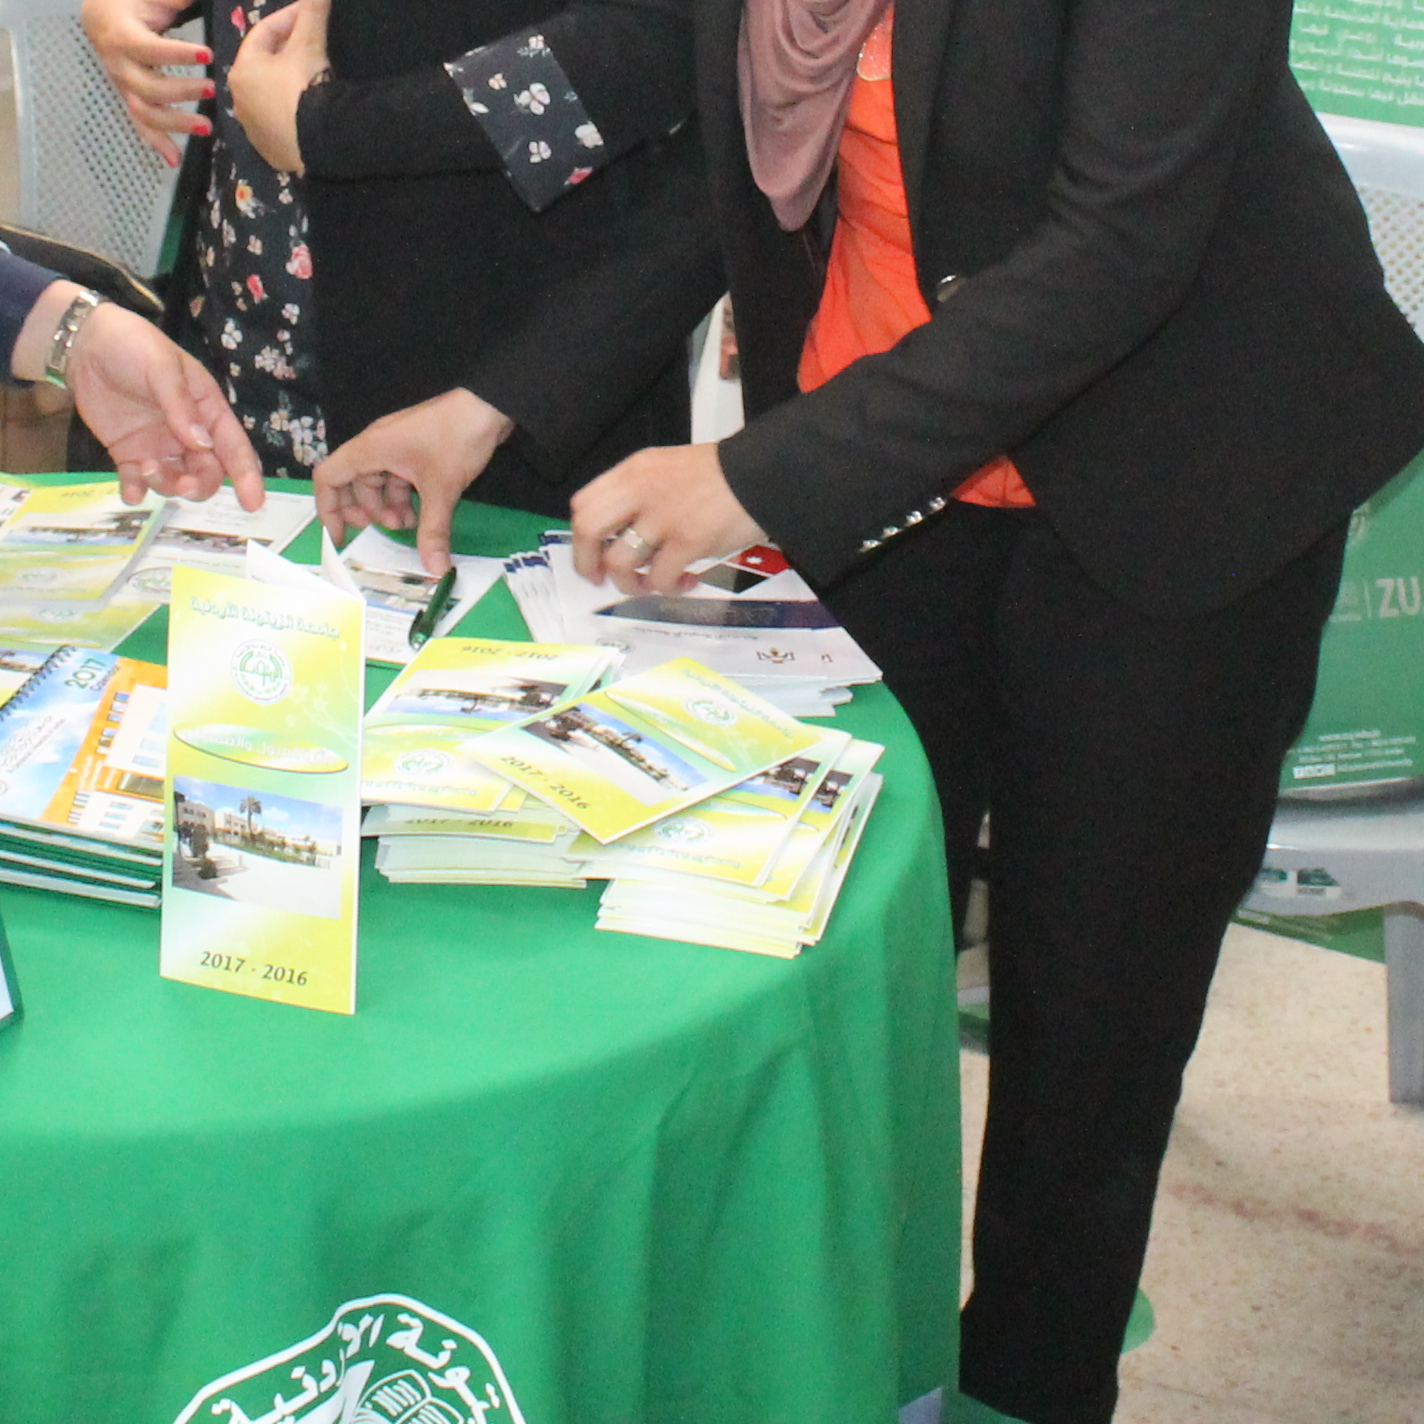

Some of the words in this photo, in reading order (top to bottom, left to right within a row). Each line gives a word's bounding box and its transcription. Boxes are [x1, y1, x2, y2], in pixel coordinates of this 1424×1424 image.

[64, 657, 107, 689] 2017
[501, 754, 544, 778] 2017
[551, 783, 591, 811] 2016
[200, 951, 245, 973] 2017
[262, 964, 308, 986] 2016
